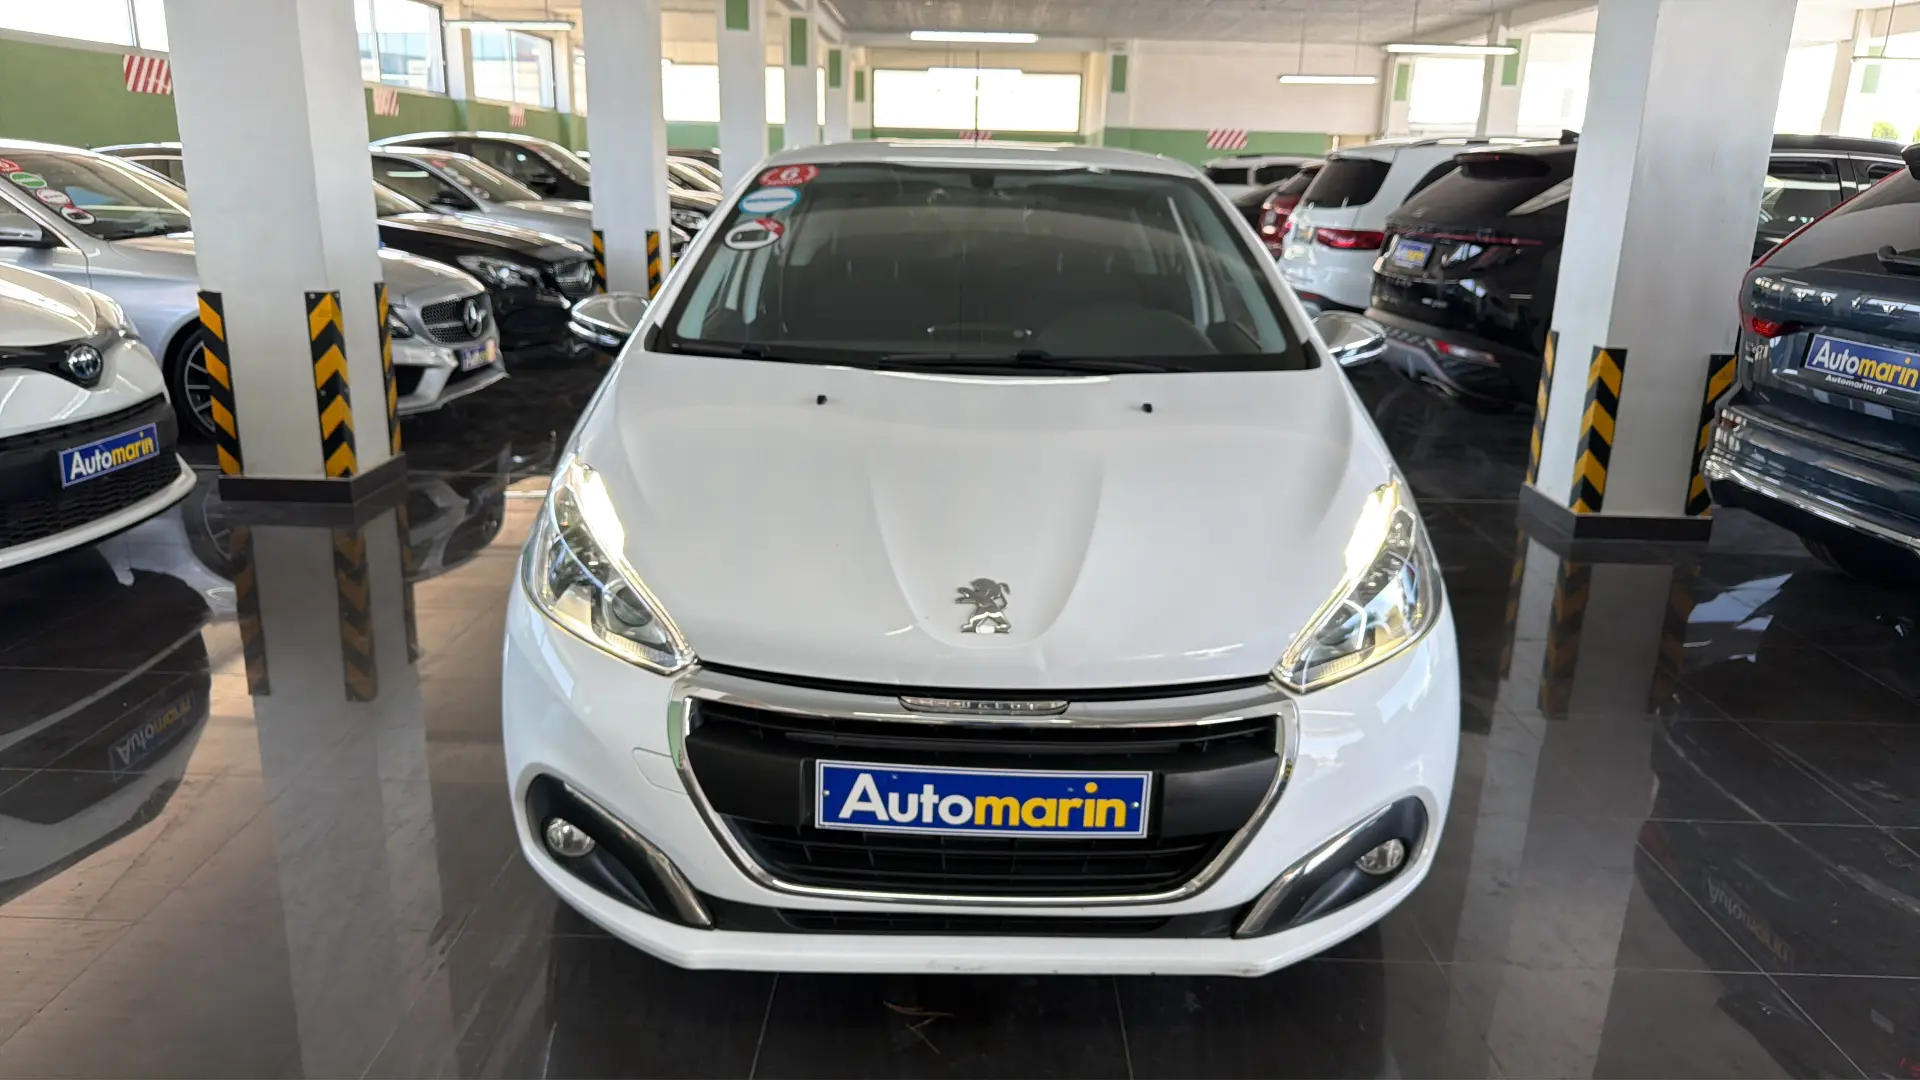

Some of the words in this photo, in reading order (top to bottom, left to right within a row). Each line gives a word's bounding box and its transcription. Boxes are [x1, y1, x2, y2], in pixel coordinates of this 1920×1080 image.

[1811, 340, 1920, 389] Automarin
[1824, 374, 1889, 396] Automarin.gr
[69, 430, 155, 481] Automarin
[837, 772, 1128, 828] Automarin
